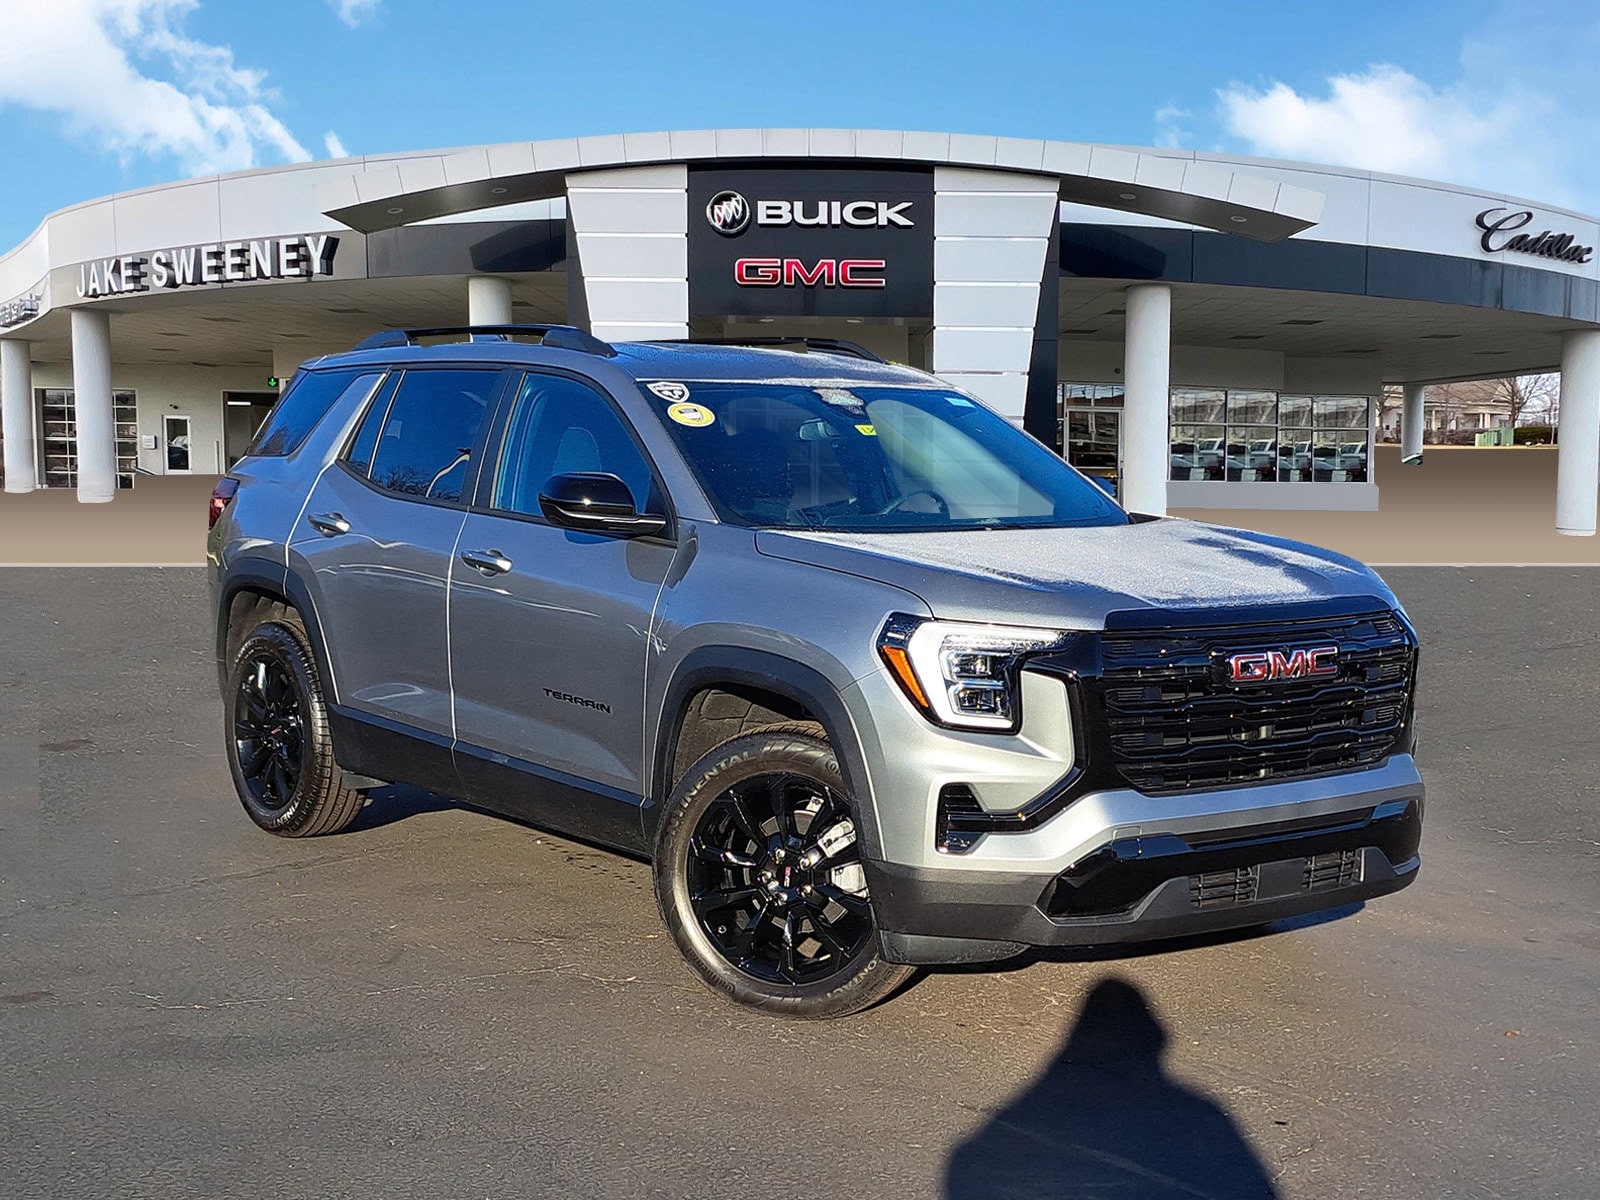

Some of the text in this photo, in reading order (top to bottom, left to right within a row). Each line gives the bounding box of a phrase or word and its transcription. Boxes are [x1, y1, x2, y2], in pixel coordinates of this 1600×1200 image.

[757, 201, 915, 226] BUICK
[1475, 207, 1593, 264] Cadillac
[76, 235, 331, 297] JAKE SWEENEY
[735, 258, 886, 286] GMC
[1231, 647, 1338, 681] GMC
[543, 687, 612, 714] TERRAIN
